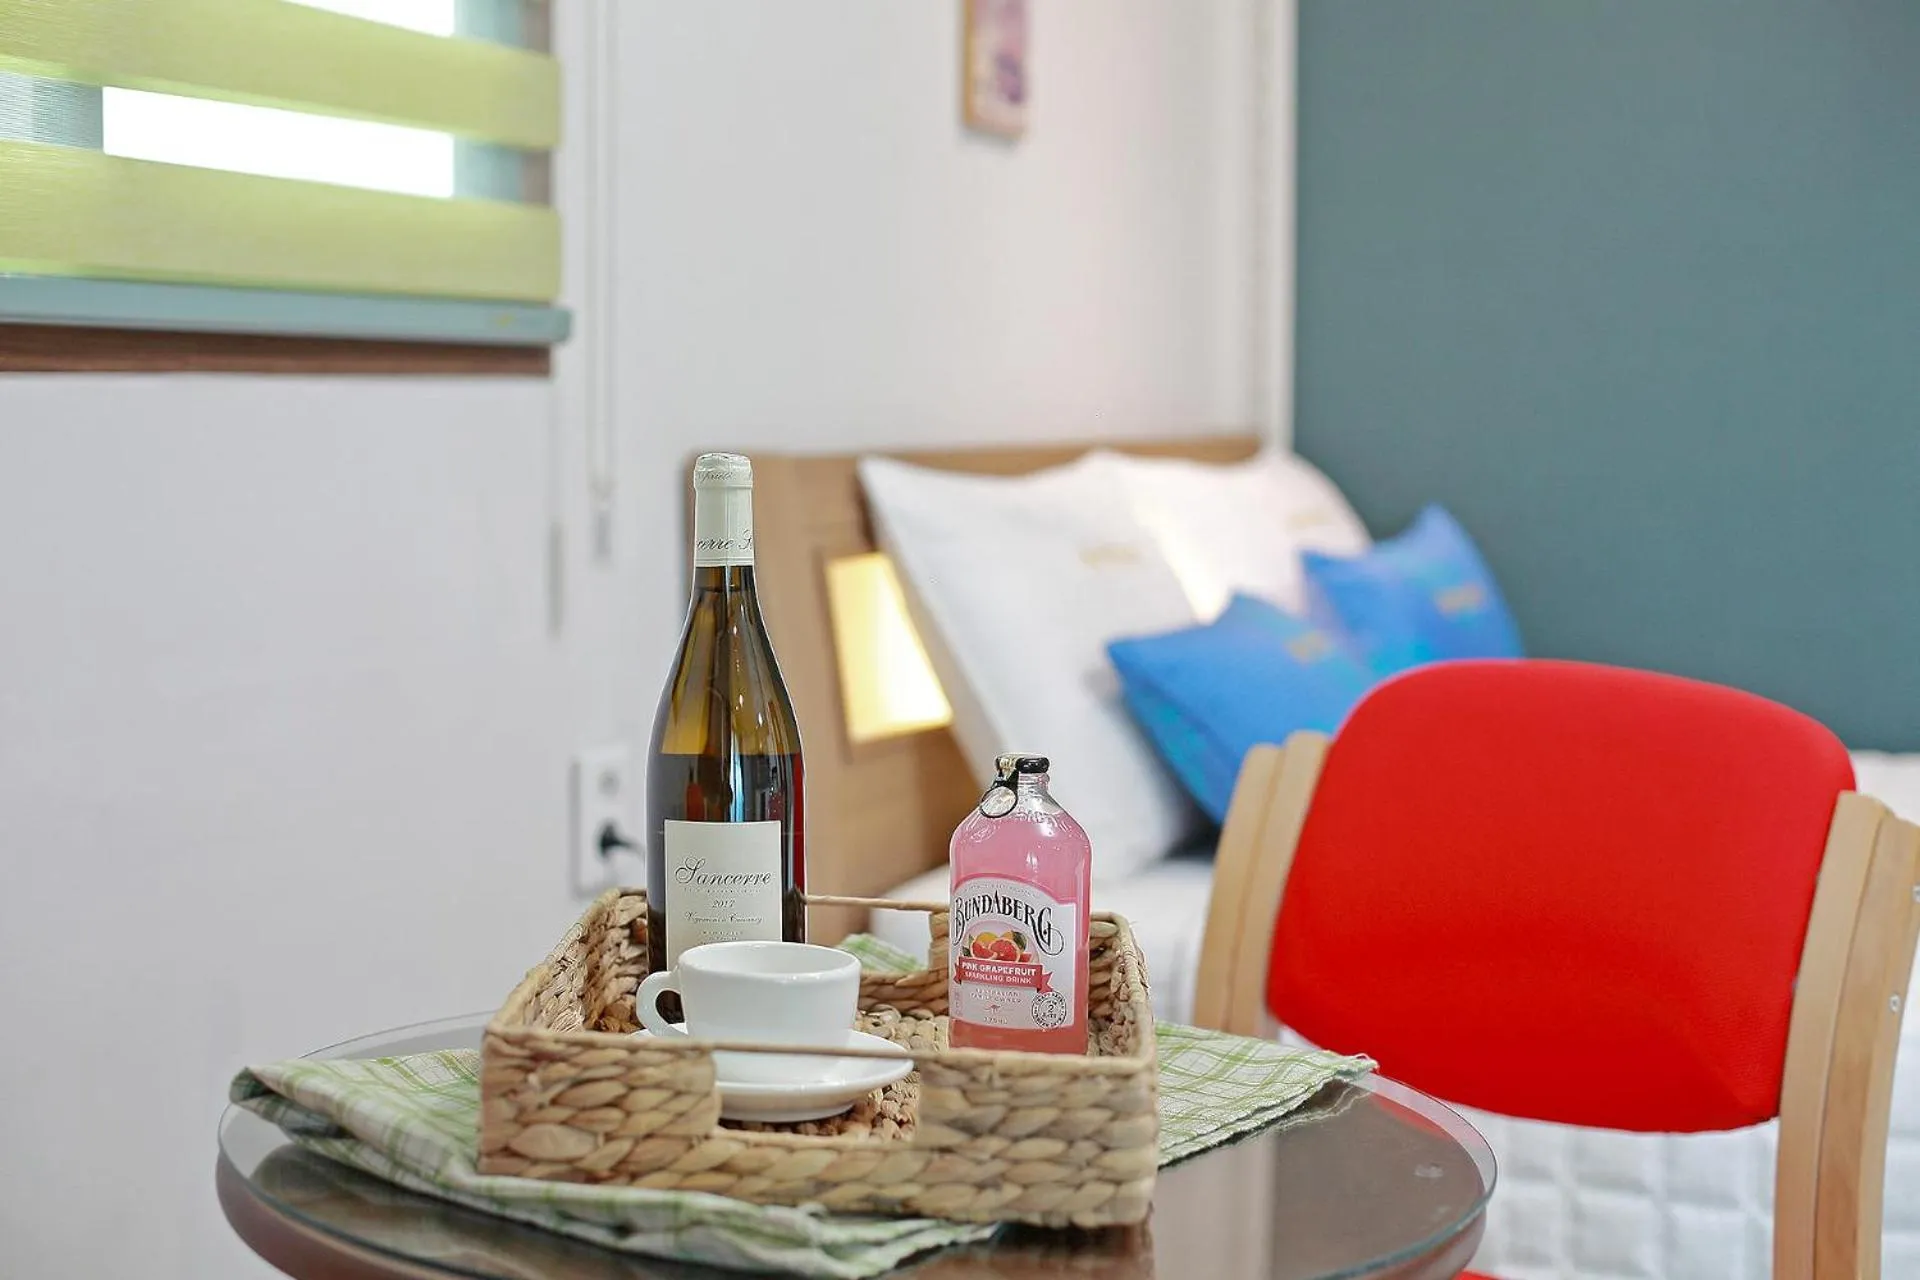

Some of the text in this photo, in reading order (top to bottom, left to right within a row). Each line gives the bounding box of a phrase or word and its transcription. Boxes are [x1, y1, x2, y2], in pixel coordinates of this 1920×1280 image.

[675, 857, 772, 885] Sancerre
[953, 890, 1065, 956] BUNDABERG
[962, 962, 1037, 976] PINK GRAPEFRUIT
[965, 971, 1032, 984] SPARKLING DRINK
